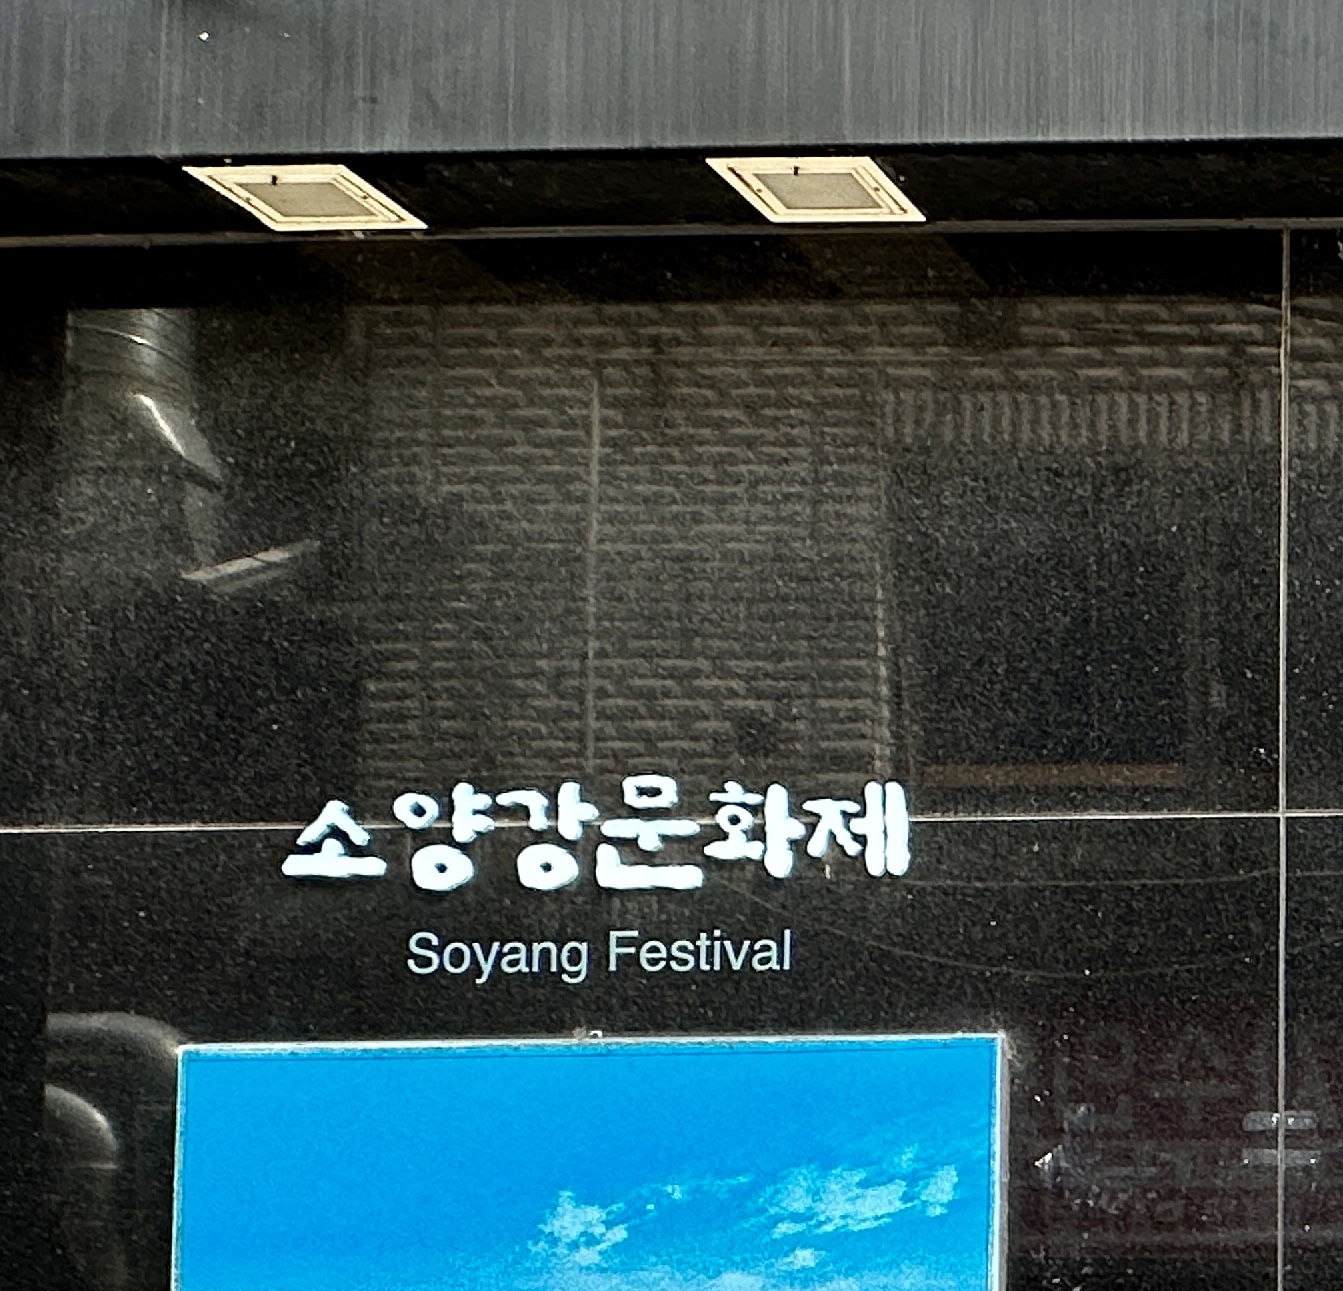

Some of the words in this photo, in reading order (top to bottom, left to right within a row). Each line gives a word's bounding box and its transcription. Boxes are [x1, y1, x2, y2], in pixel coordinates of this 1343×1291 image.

[281, 773, 912, 892] 소양강문화제
[406, 932, 590, 984] Soyang
[608, 928, 792, 972] Festival
